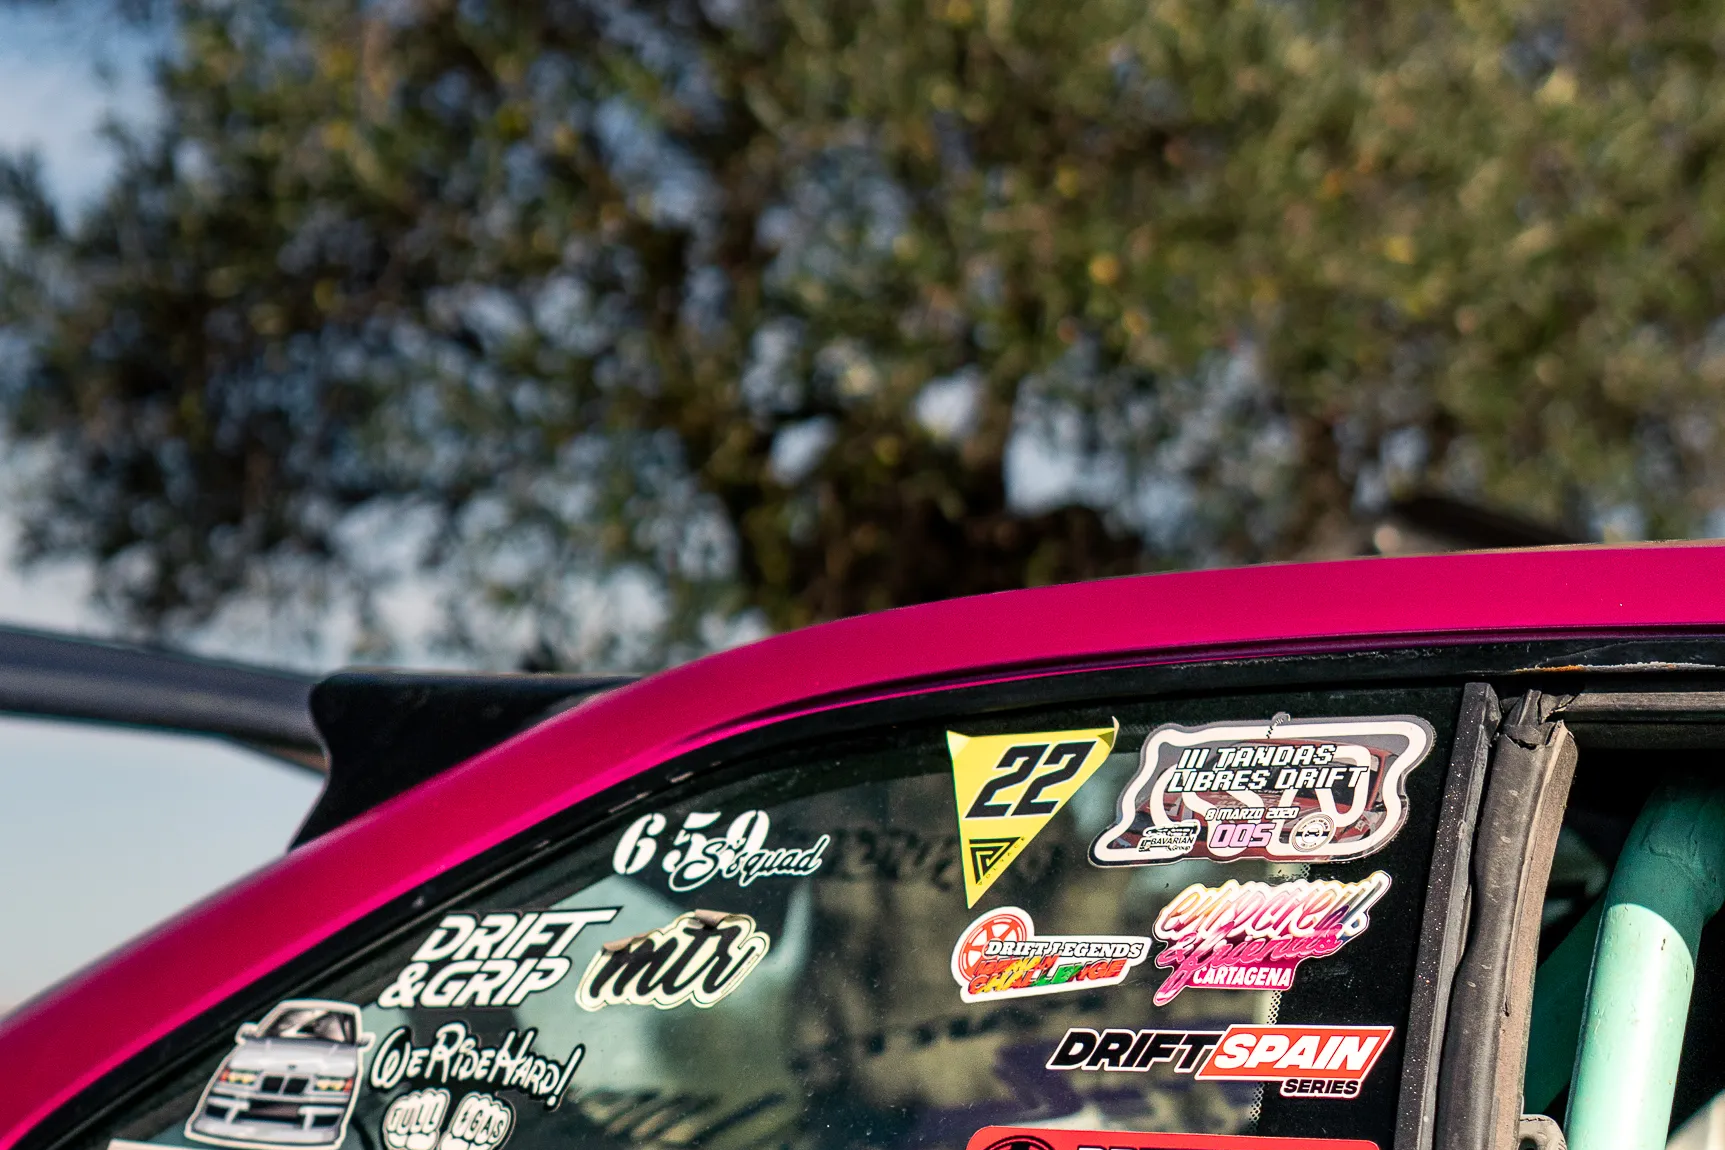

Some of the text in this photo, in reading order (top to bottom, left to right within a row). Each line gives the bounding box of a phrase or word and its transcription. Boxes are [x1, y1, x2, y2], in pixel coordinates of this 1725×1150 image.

[1178, 743, 1337, 769] III TANDAS
[963, 741, 1099, 819] 22
[1167, 765, 1369, 792] LIBRES DRIFT
[1216, 806, 1264, 820] MARZO
[411, 909, 620, 962] DRIFT
[984, 939, 1145, 959] DRIFT LEGENDS
[1192, 966, 1292, 987] CARTAGENA
[1283, 1077, 1359, 1096] SERIES
